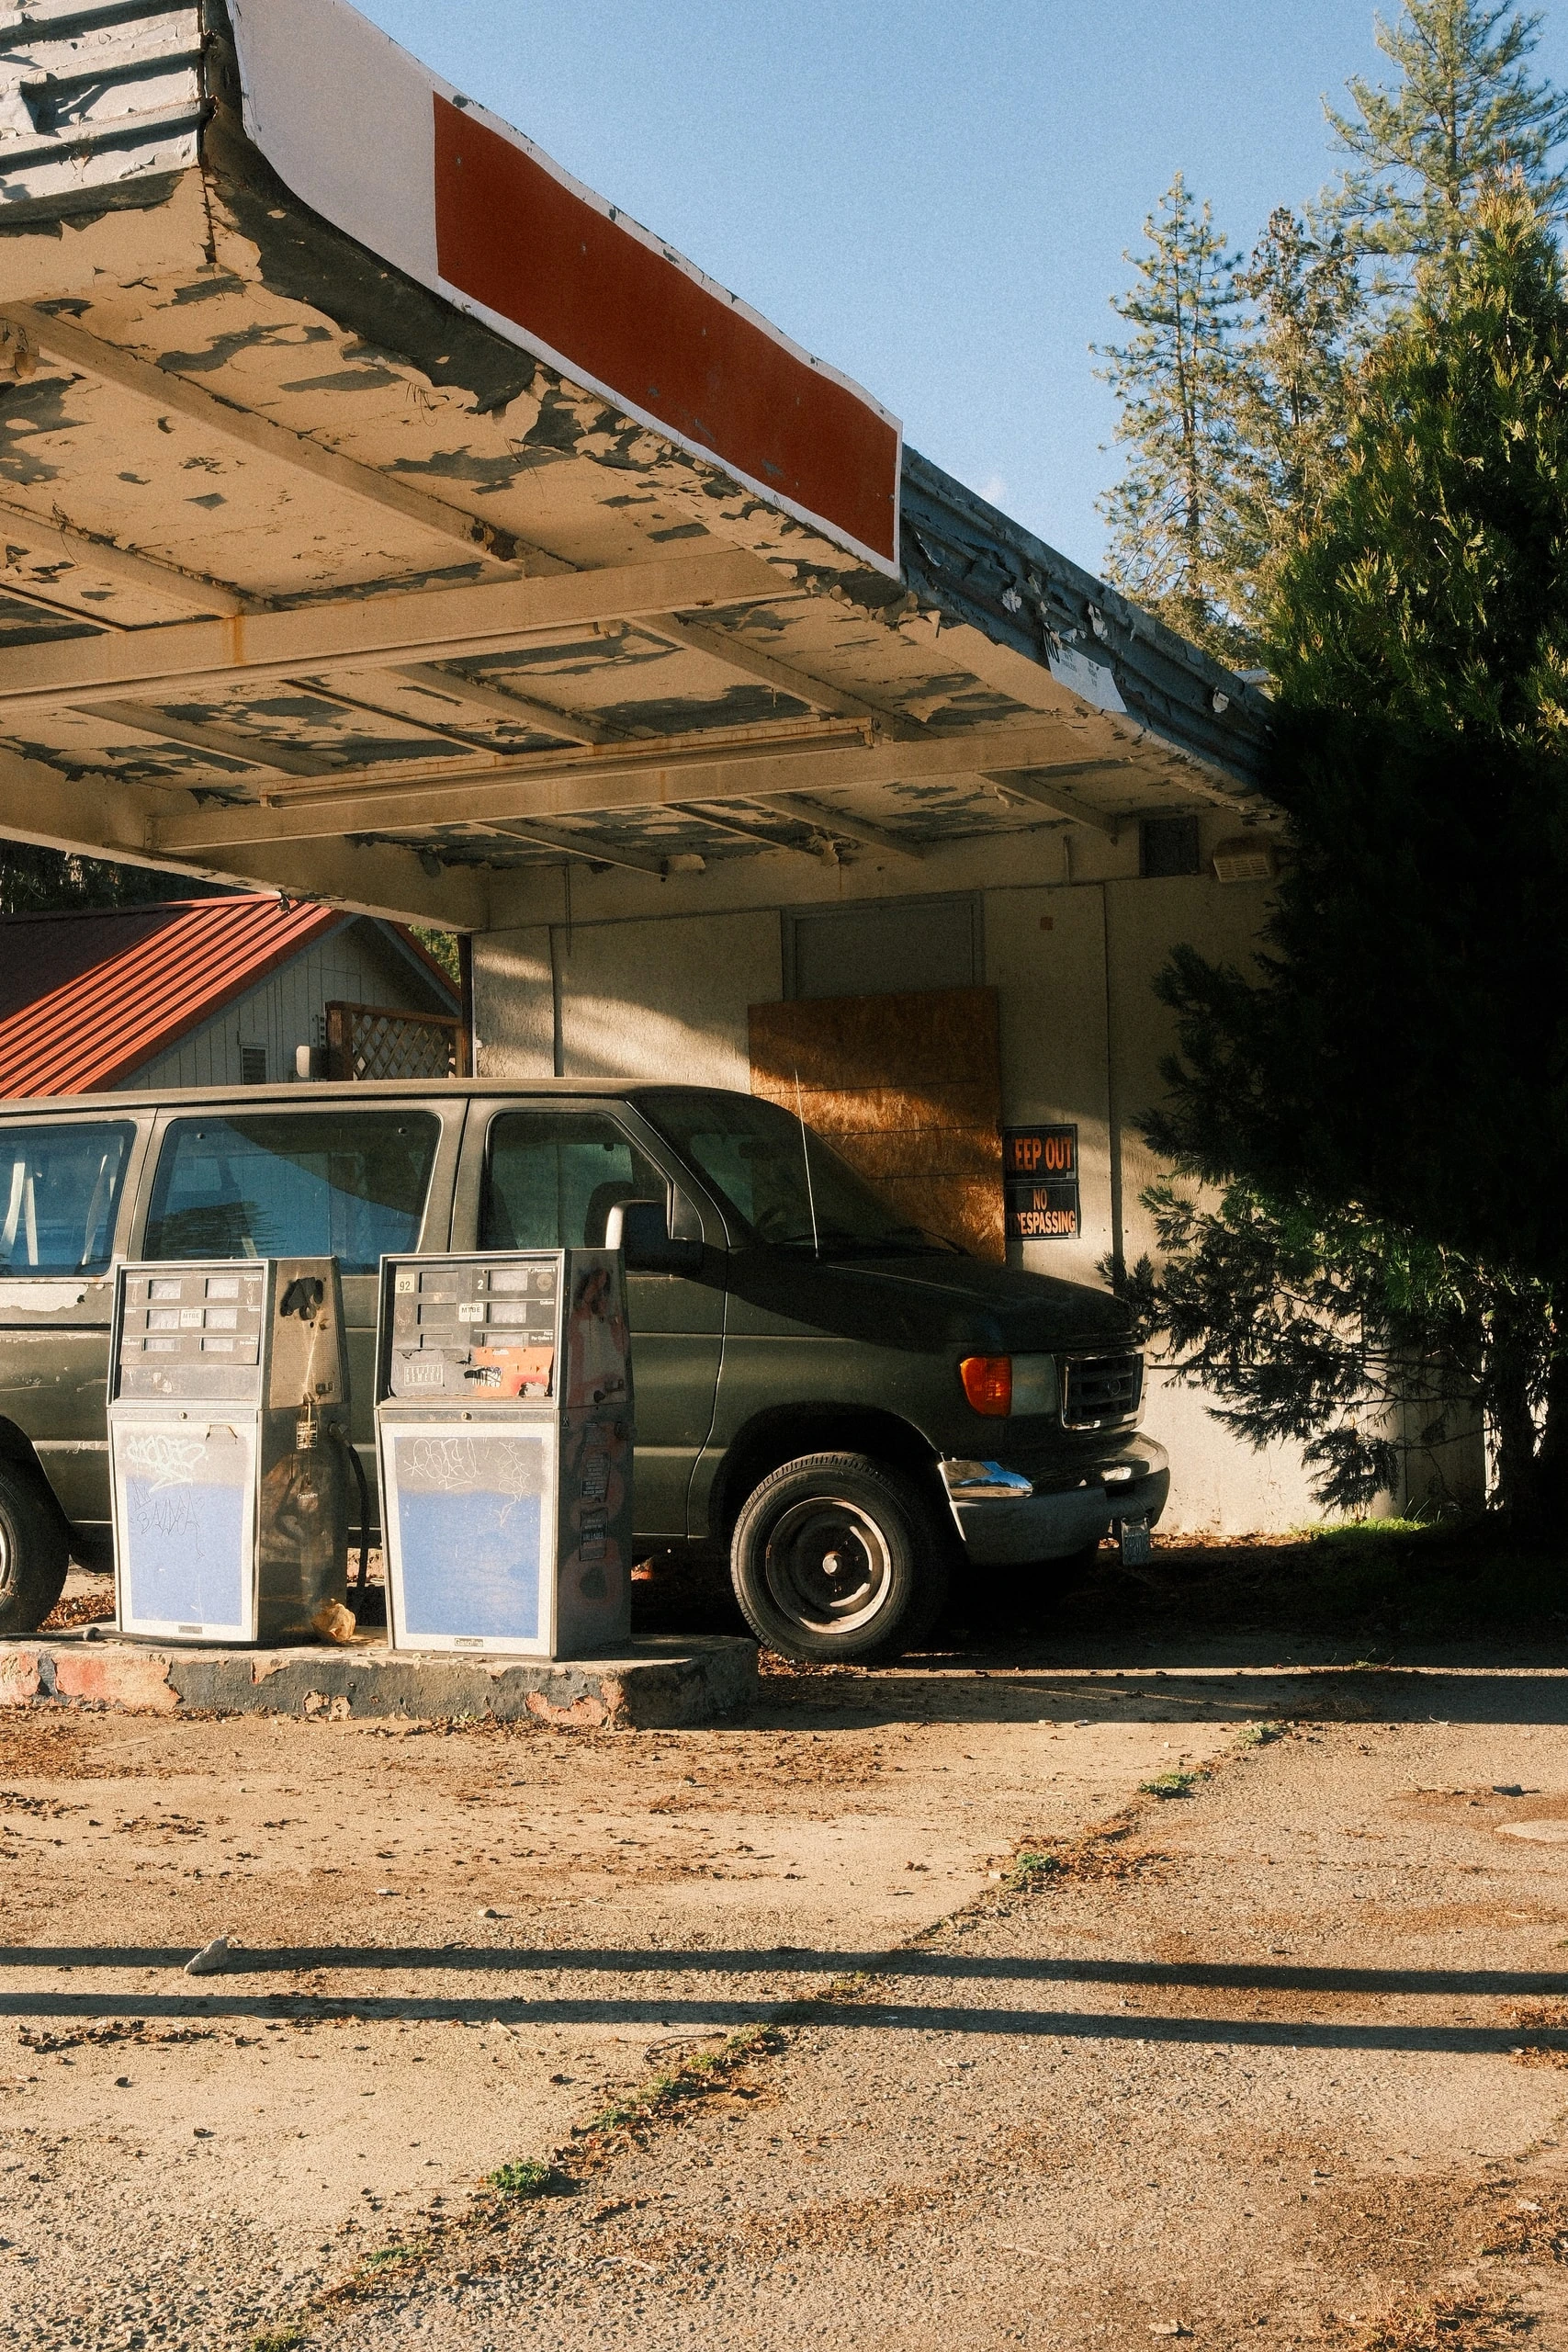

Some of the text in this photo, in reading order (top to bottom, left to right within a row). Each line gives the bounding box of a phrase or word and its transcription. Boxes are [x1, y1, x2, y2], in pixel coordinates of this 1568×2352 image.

[1012, 1137, 1072, 1170] EEP OUT
[1032, 1189, 1047, 1210] NO
[1013, 1211, 1076, 1235] ESPASSING
[400, 1281, 411, 1291] 92
[477, 1279, 484, 1290] 2
